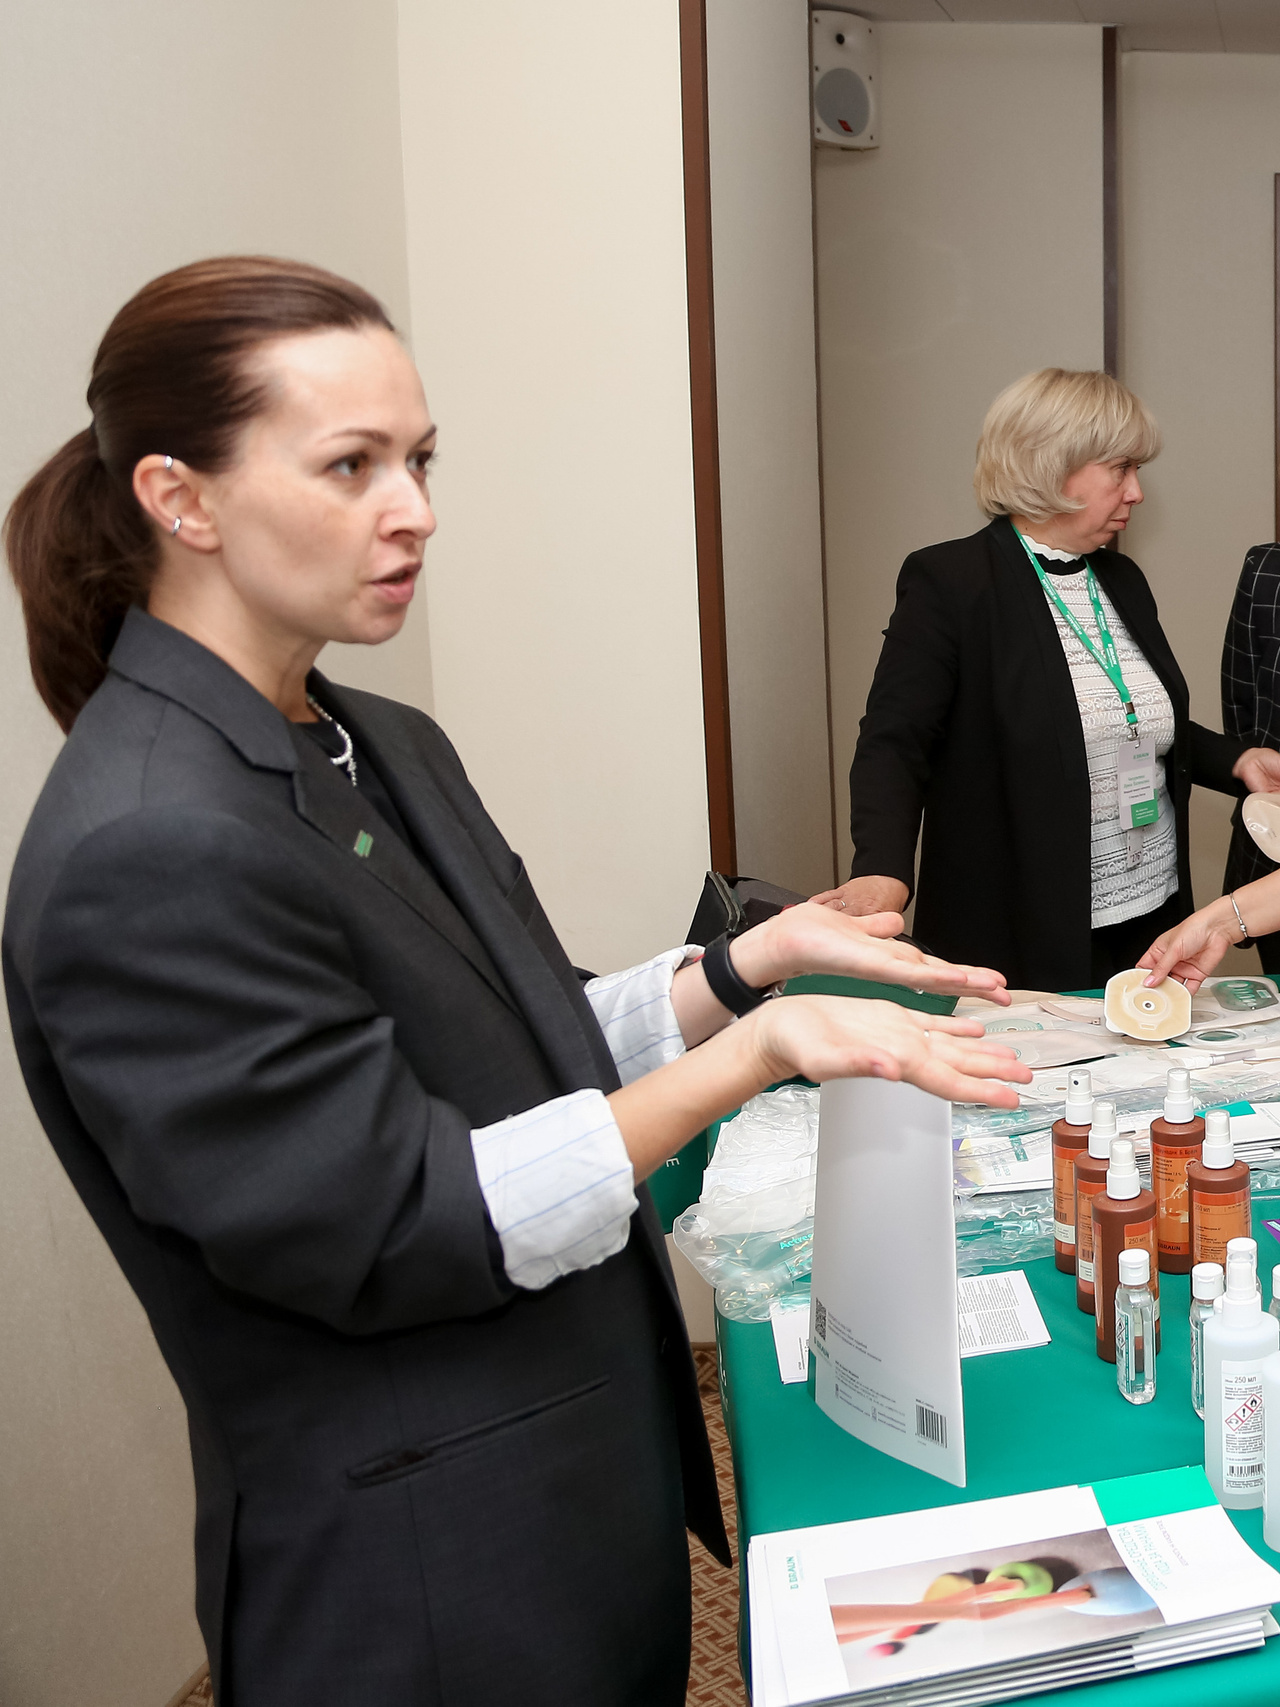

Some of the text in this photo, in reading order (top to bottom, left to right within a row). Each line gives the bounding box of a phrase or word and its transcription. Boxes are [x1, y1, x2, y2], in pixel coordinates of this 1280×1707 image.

[779, 1233, 814, 1250] Actree
[1128, 1237, 1138, 1245] 250
[786, 1556, 798, 1583] BRAUN
